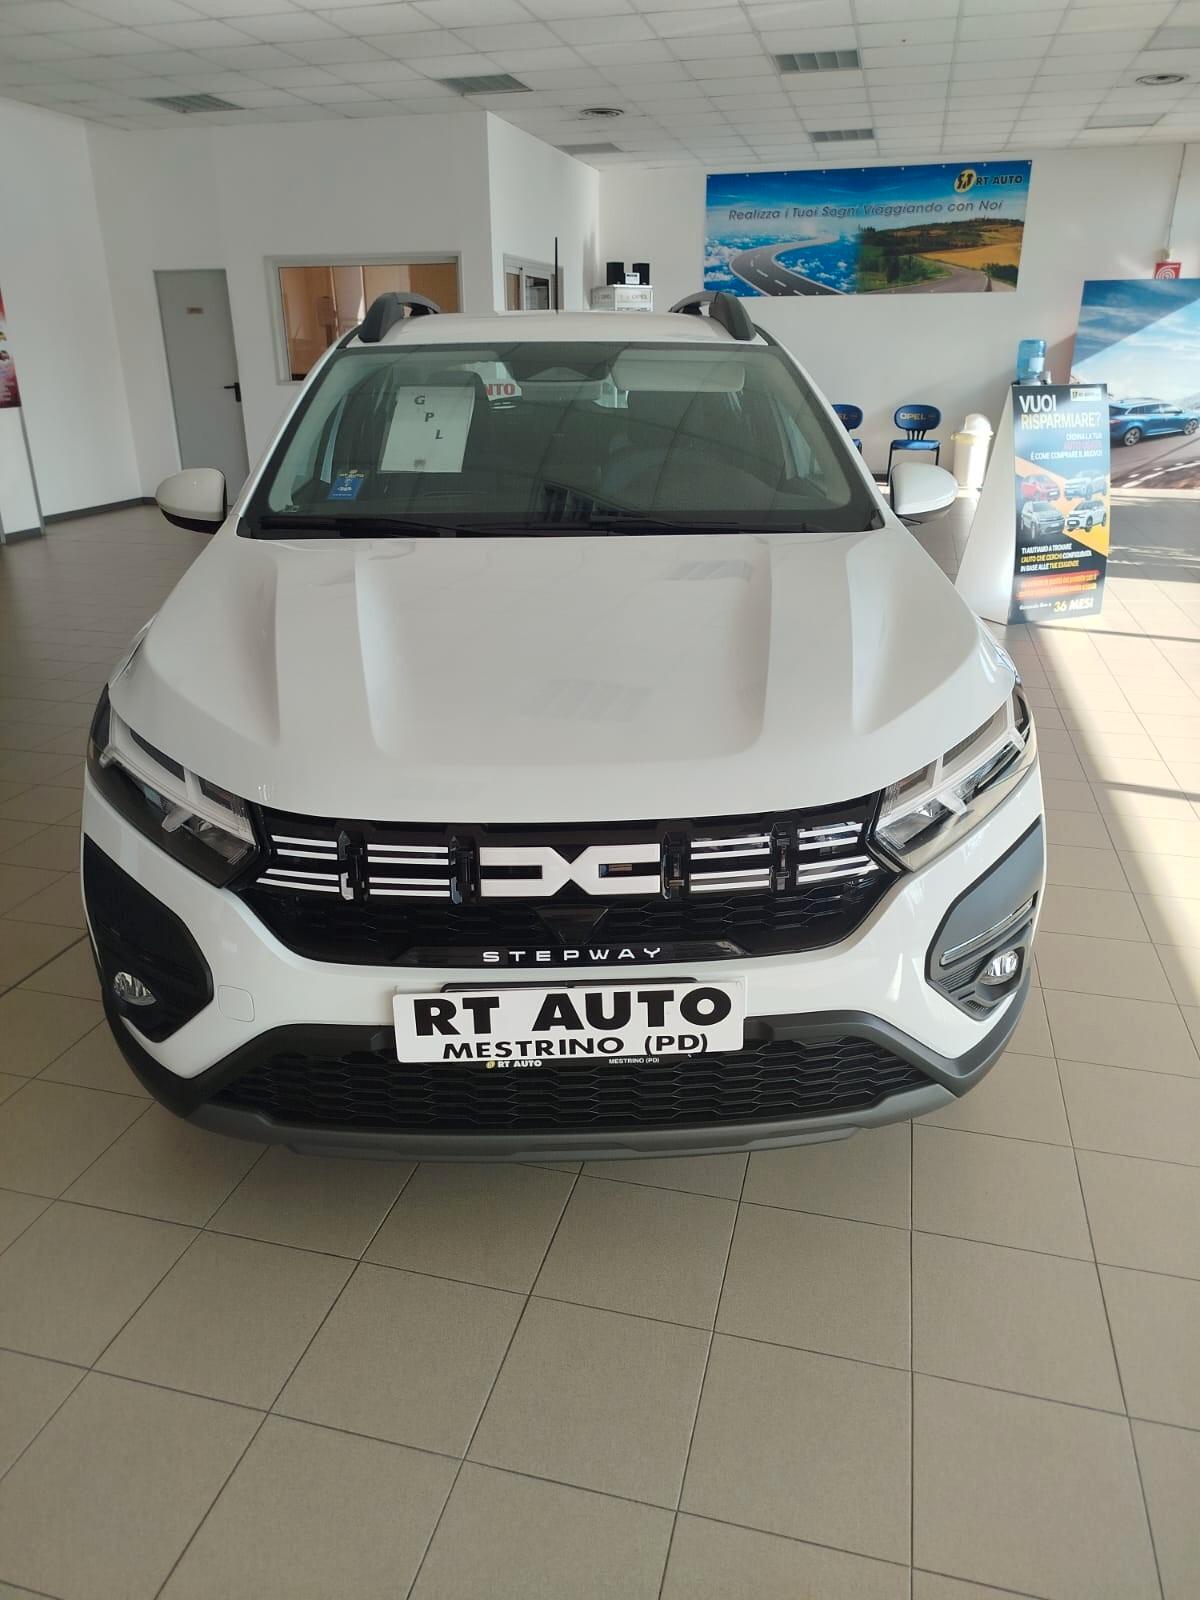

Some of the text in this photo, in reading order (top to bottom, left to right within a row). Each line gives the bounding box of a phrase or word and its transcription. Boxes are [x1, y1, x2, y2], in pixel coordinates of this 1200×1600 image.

[976, 175, 1023, 185] RT AUTO
[729, 209, 781, 220] Realizza
[792, 206, 818, 218] Tuoi
[821, 206, 859, 219] Sogni
[863, 202, 943, 217] Viaggiando
[947, 202, 974, 212] con
[978, 199, 1004, 211] Noi
[1019, 394, 1057, 413] VUOI
[1021, 411, 1102, 430] RISPARMIARE?
[1053, 600, 1068, 613] 36
[482, 947, 661, 963] STEPWAY
[413, 987, 733, 1037] RT AUTO
[442, 1033, 708, 1060] MESTRINO (PD)
[513, 1060, 542, 1068] AUTO
[608, 1057, 660, 1065] MESTRINO (PD)
